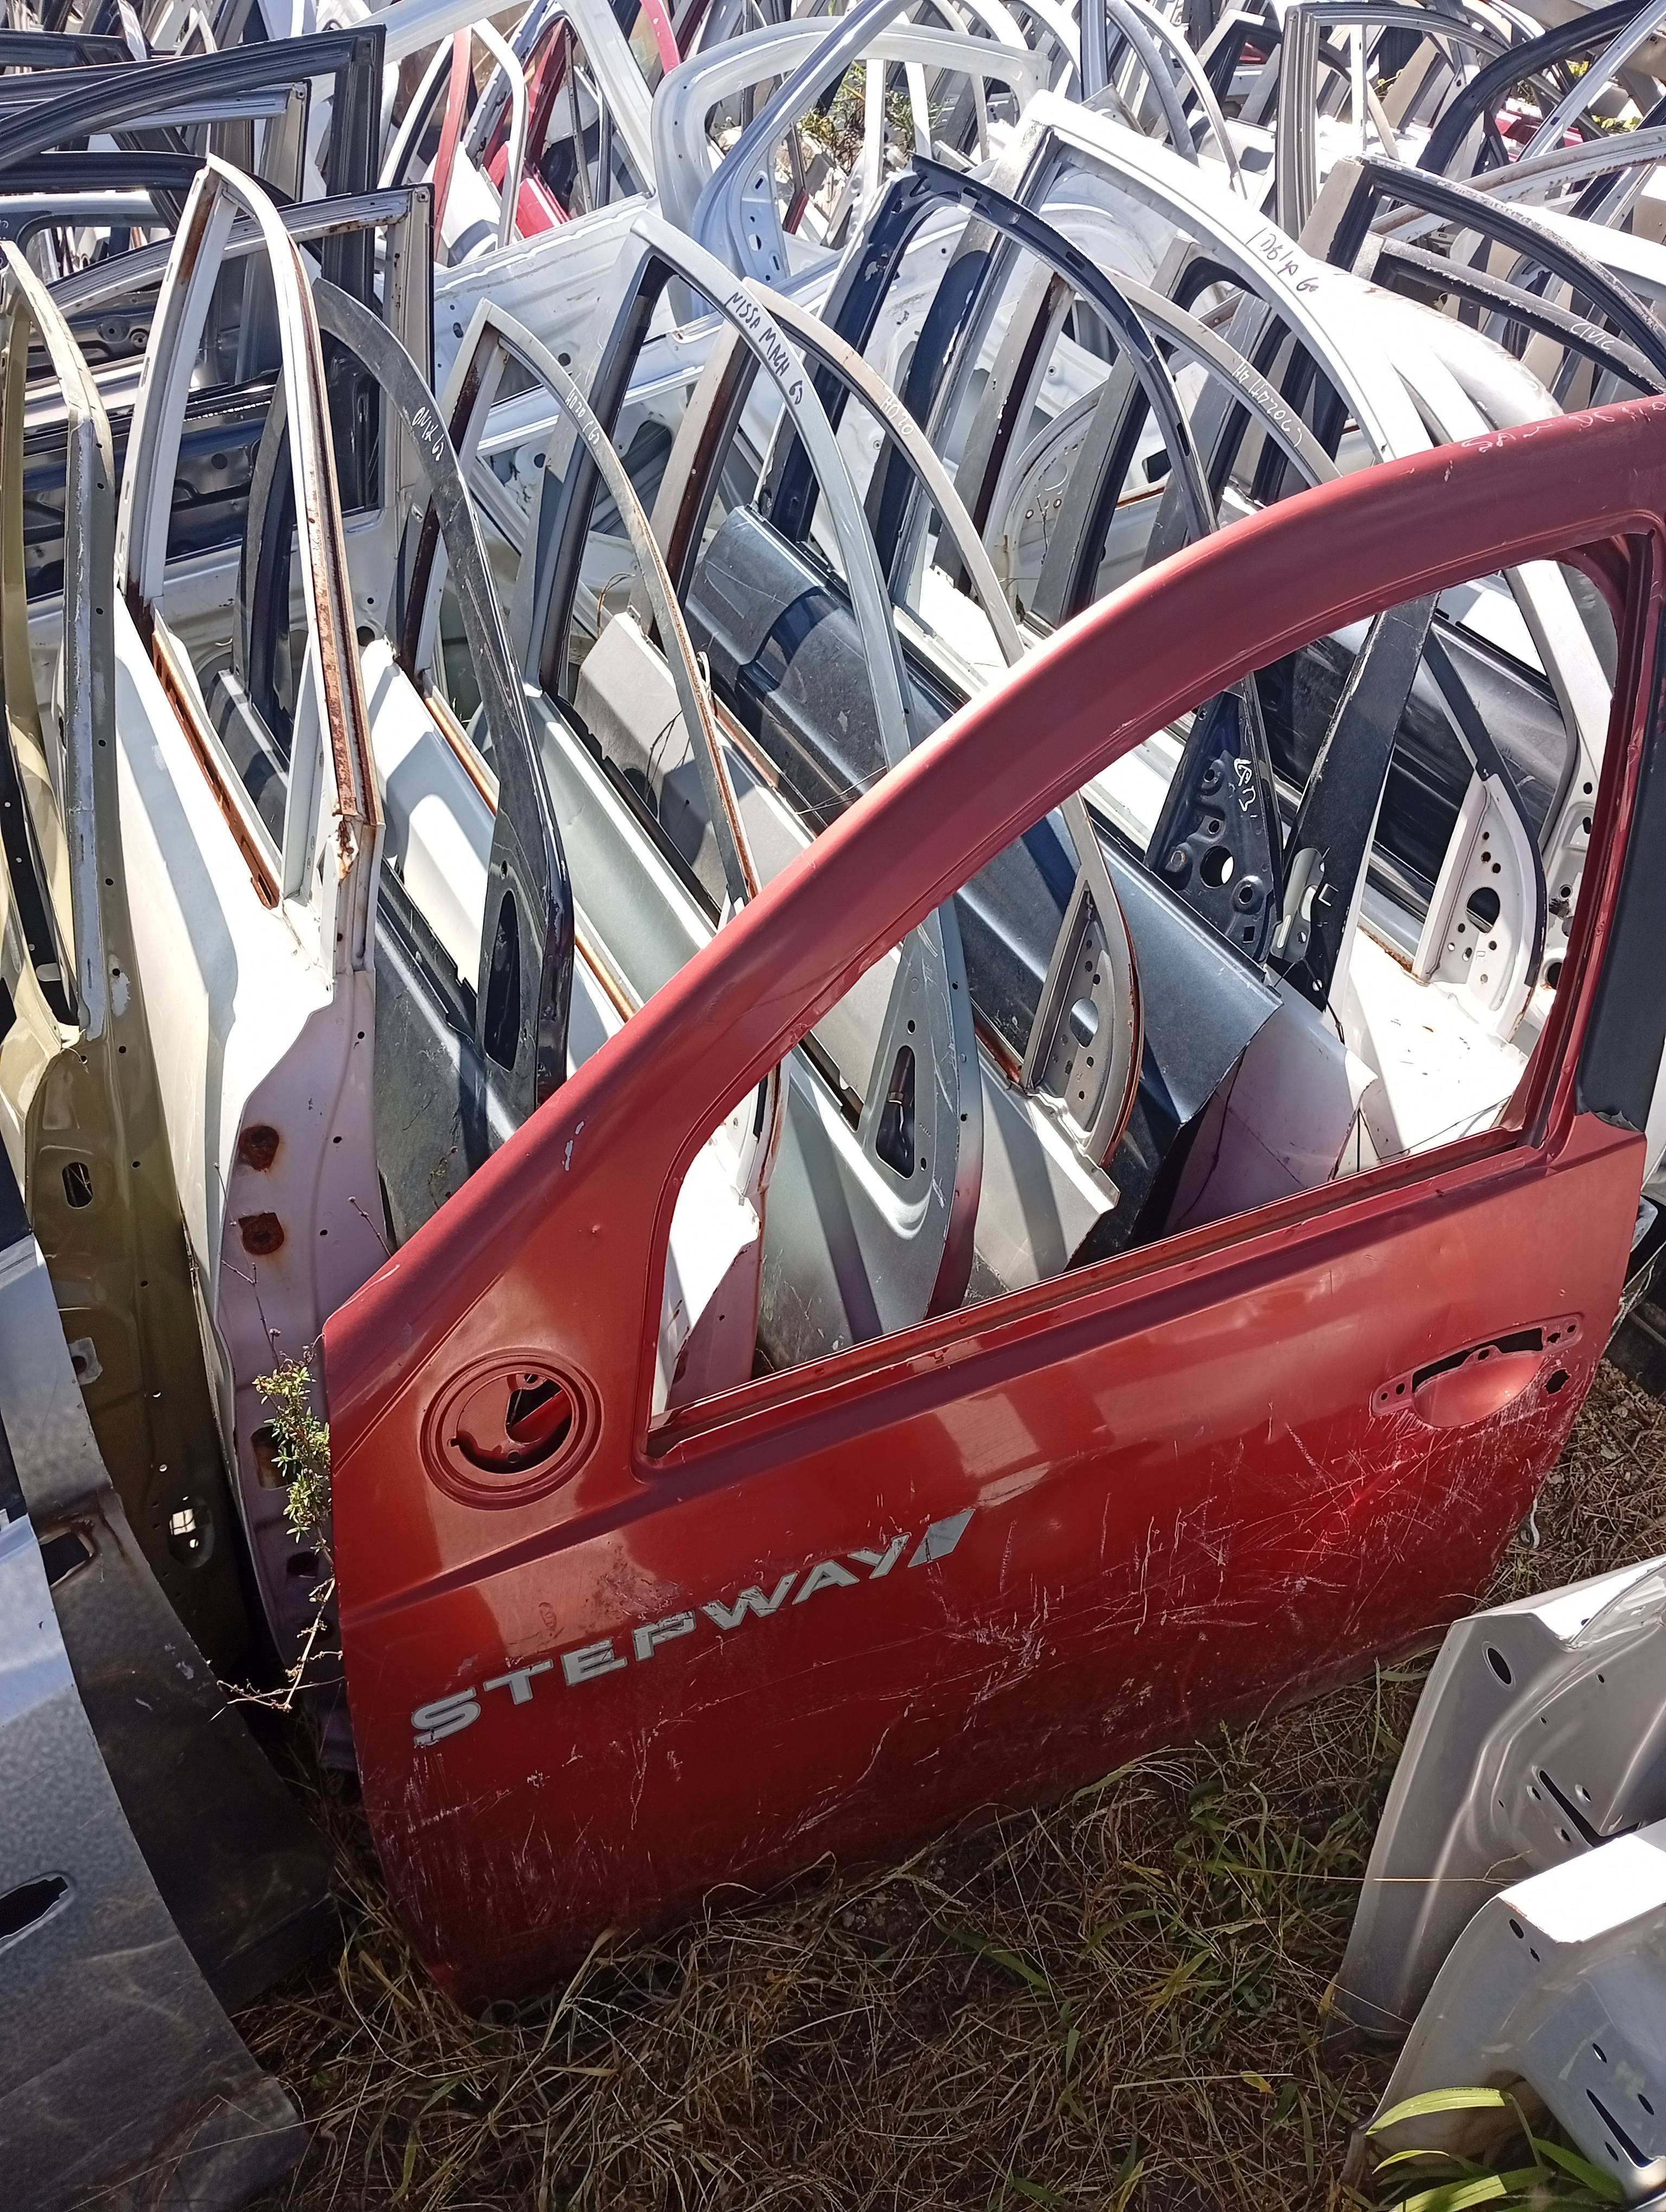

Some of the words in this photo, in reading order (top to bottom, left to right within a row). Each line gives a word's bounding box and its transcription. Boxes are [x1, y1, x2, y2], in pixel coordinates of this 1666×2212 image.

[1570, 323, 1614, 350] CIVIC
[412, 407, 438, 441] ONIX
[411, 1532, 909, 1745] STEPWAY
